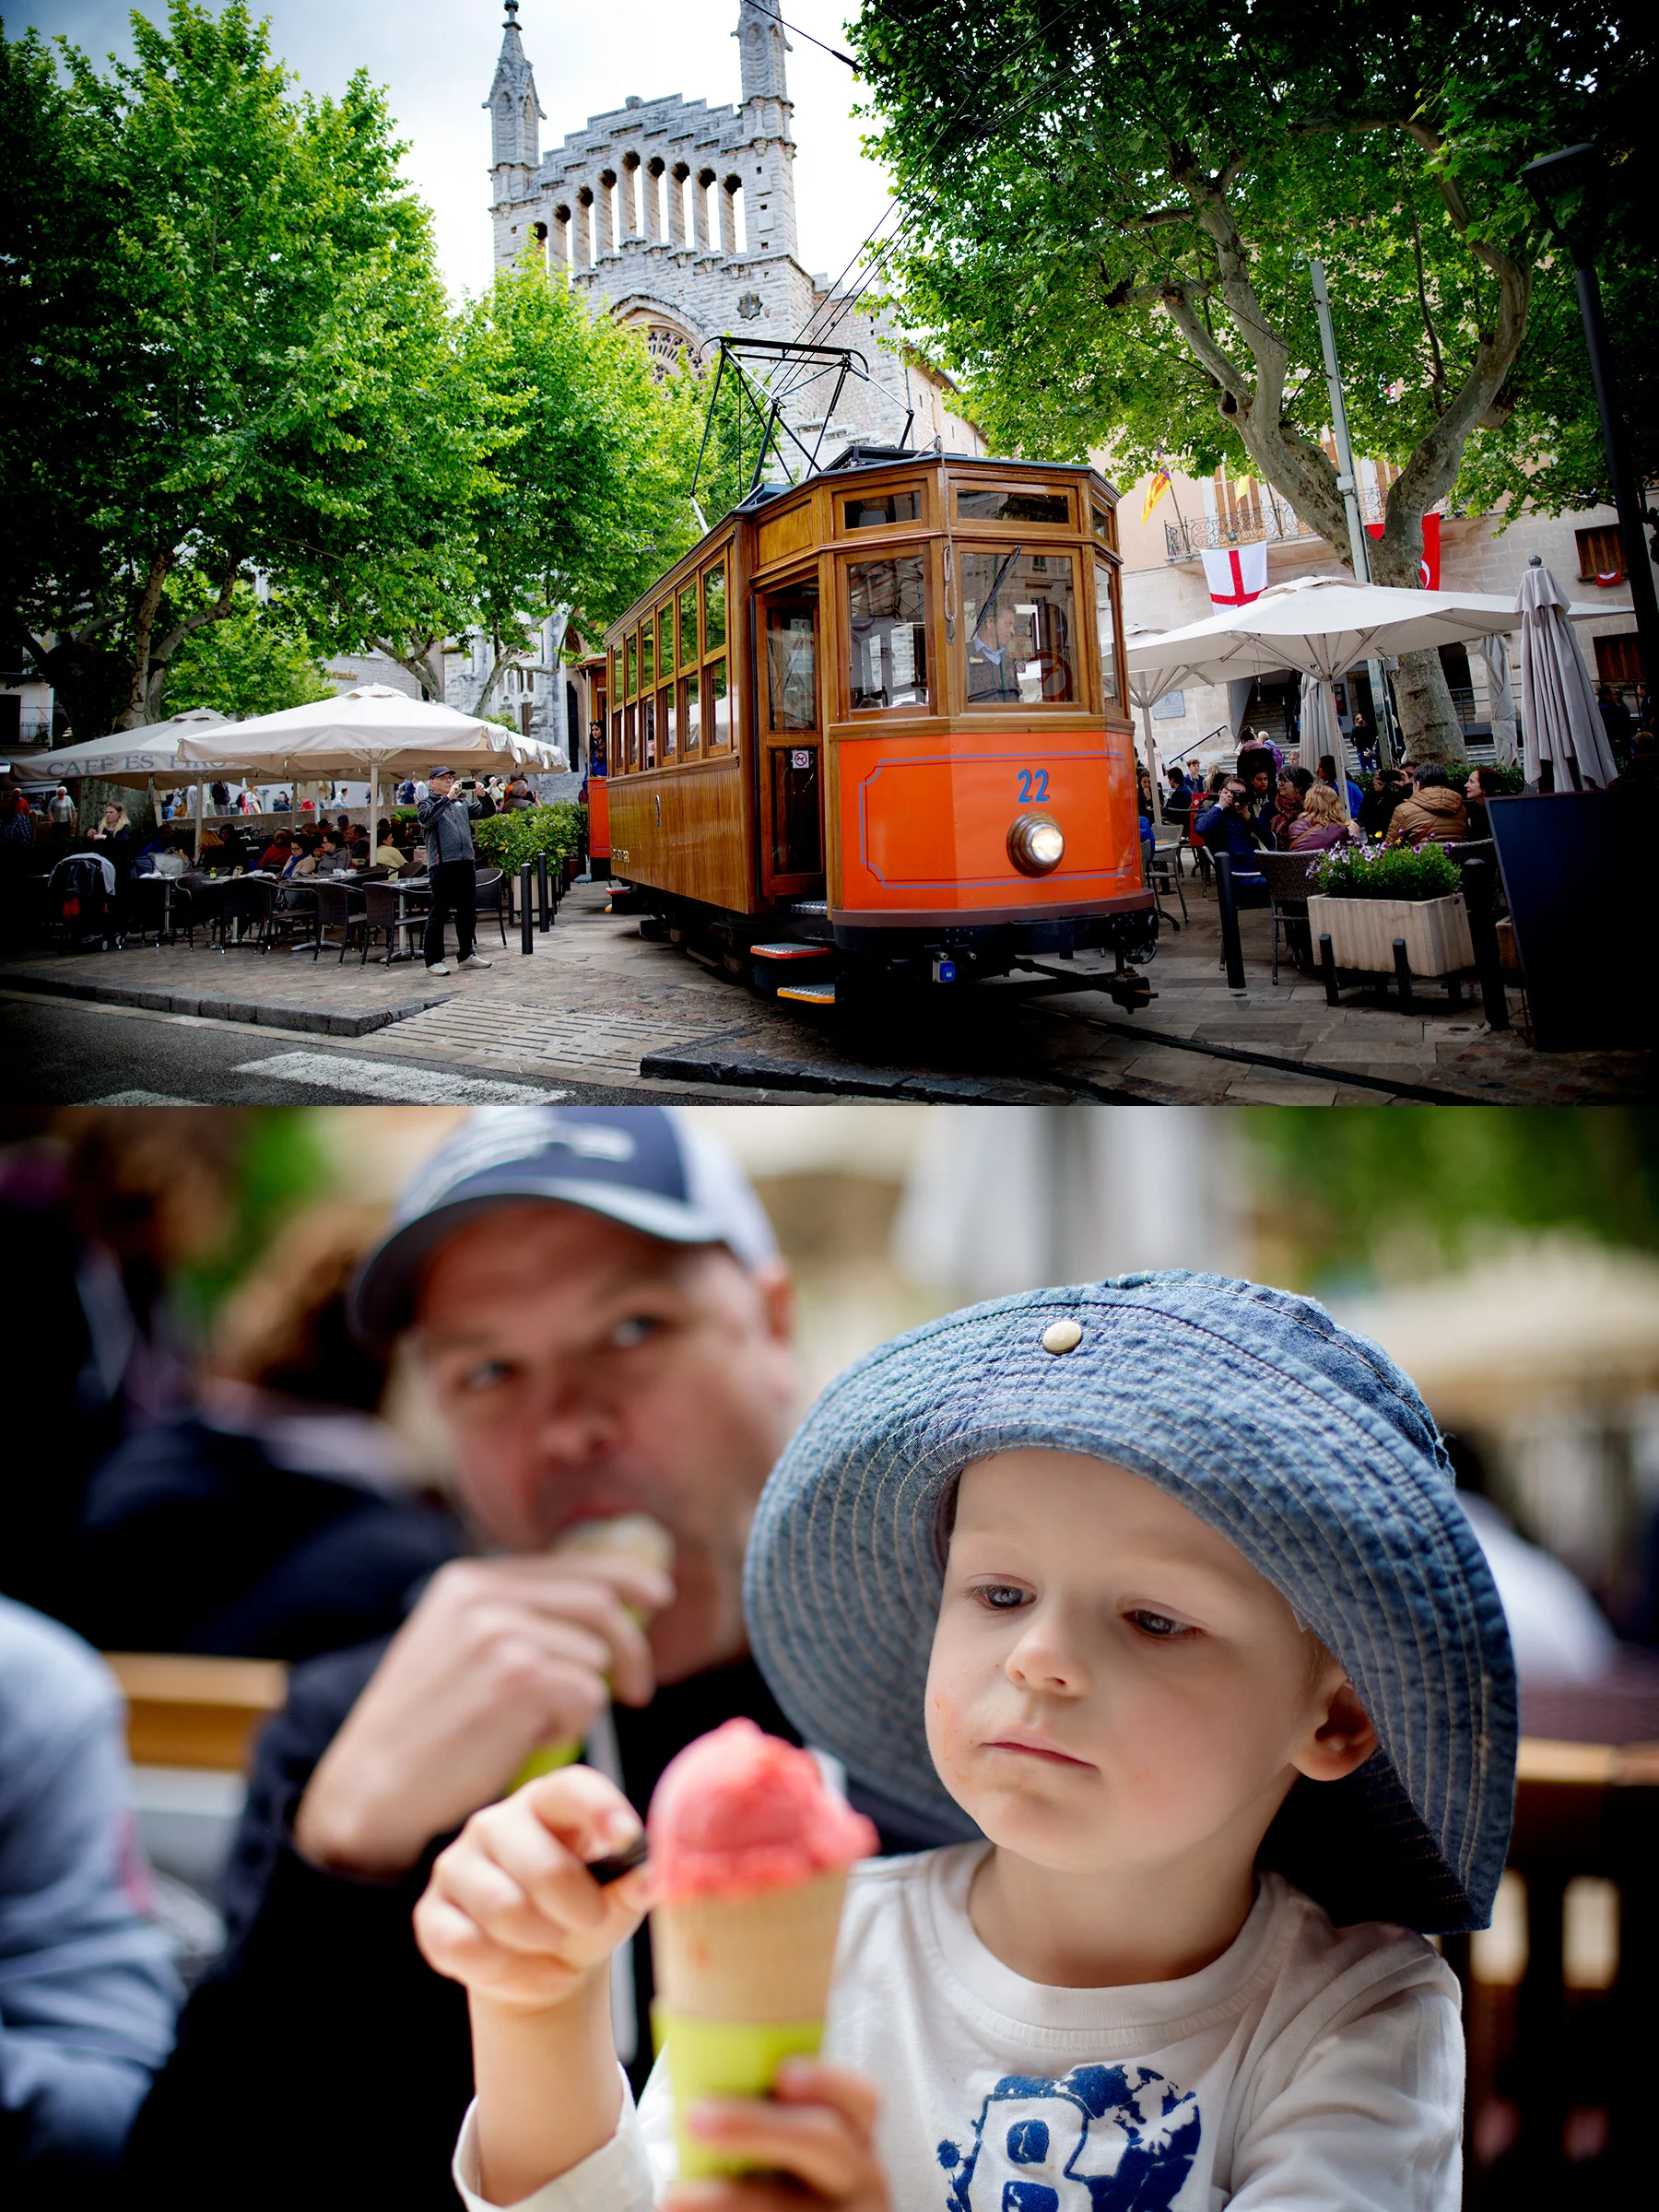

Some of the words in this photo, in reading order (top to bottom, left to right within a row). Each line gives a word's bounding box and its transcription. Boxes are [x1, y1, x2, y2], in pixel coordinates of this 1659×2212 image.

[46, 756, 114, 776] CAFÈ
[124, 755, 154, 771] ES
[1017, 768, 1050, 804] 22
